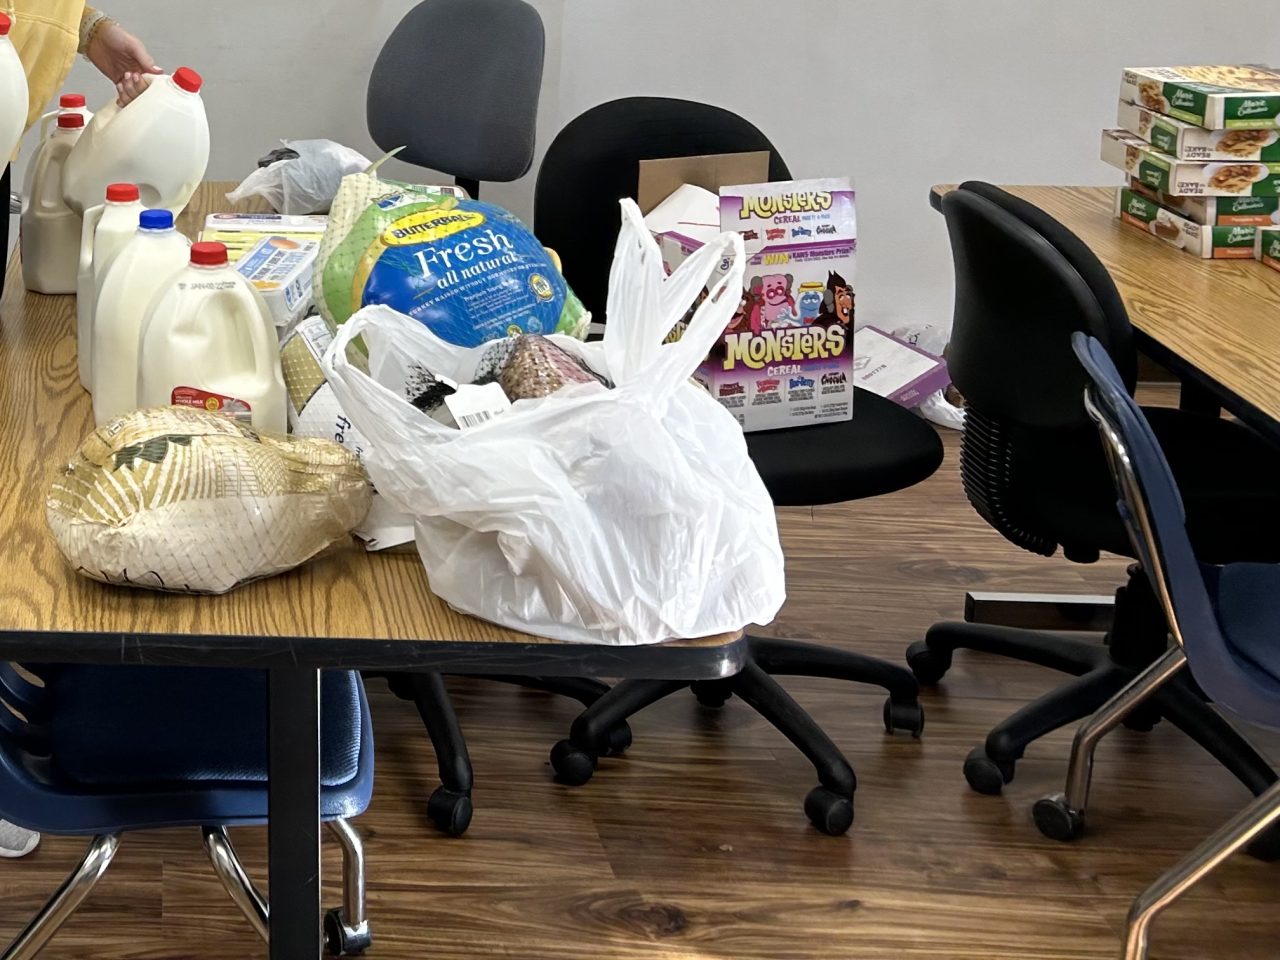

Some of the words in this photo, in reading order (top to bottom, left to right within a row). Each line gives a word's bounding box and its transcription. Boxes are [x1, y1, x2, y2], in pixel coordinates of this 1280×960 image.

[773, 215, 801, 225] CEREAL
[413, 229, 515, 280] Fresh
[763, 253, 790, 266] WIN
[437, 271, 459, 290] all
[461, 251, 521, 280] natural
[723, 324, 846, 372] MONSTERS
[767, 364, 803, 377] CEREAL
